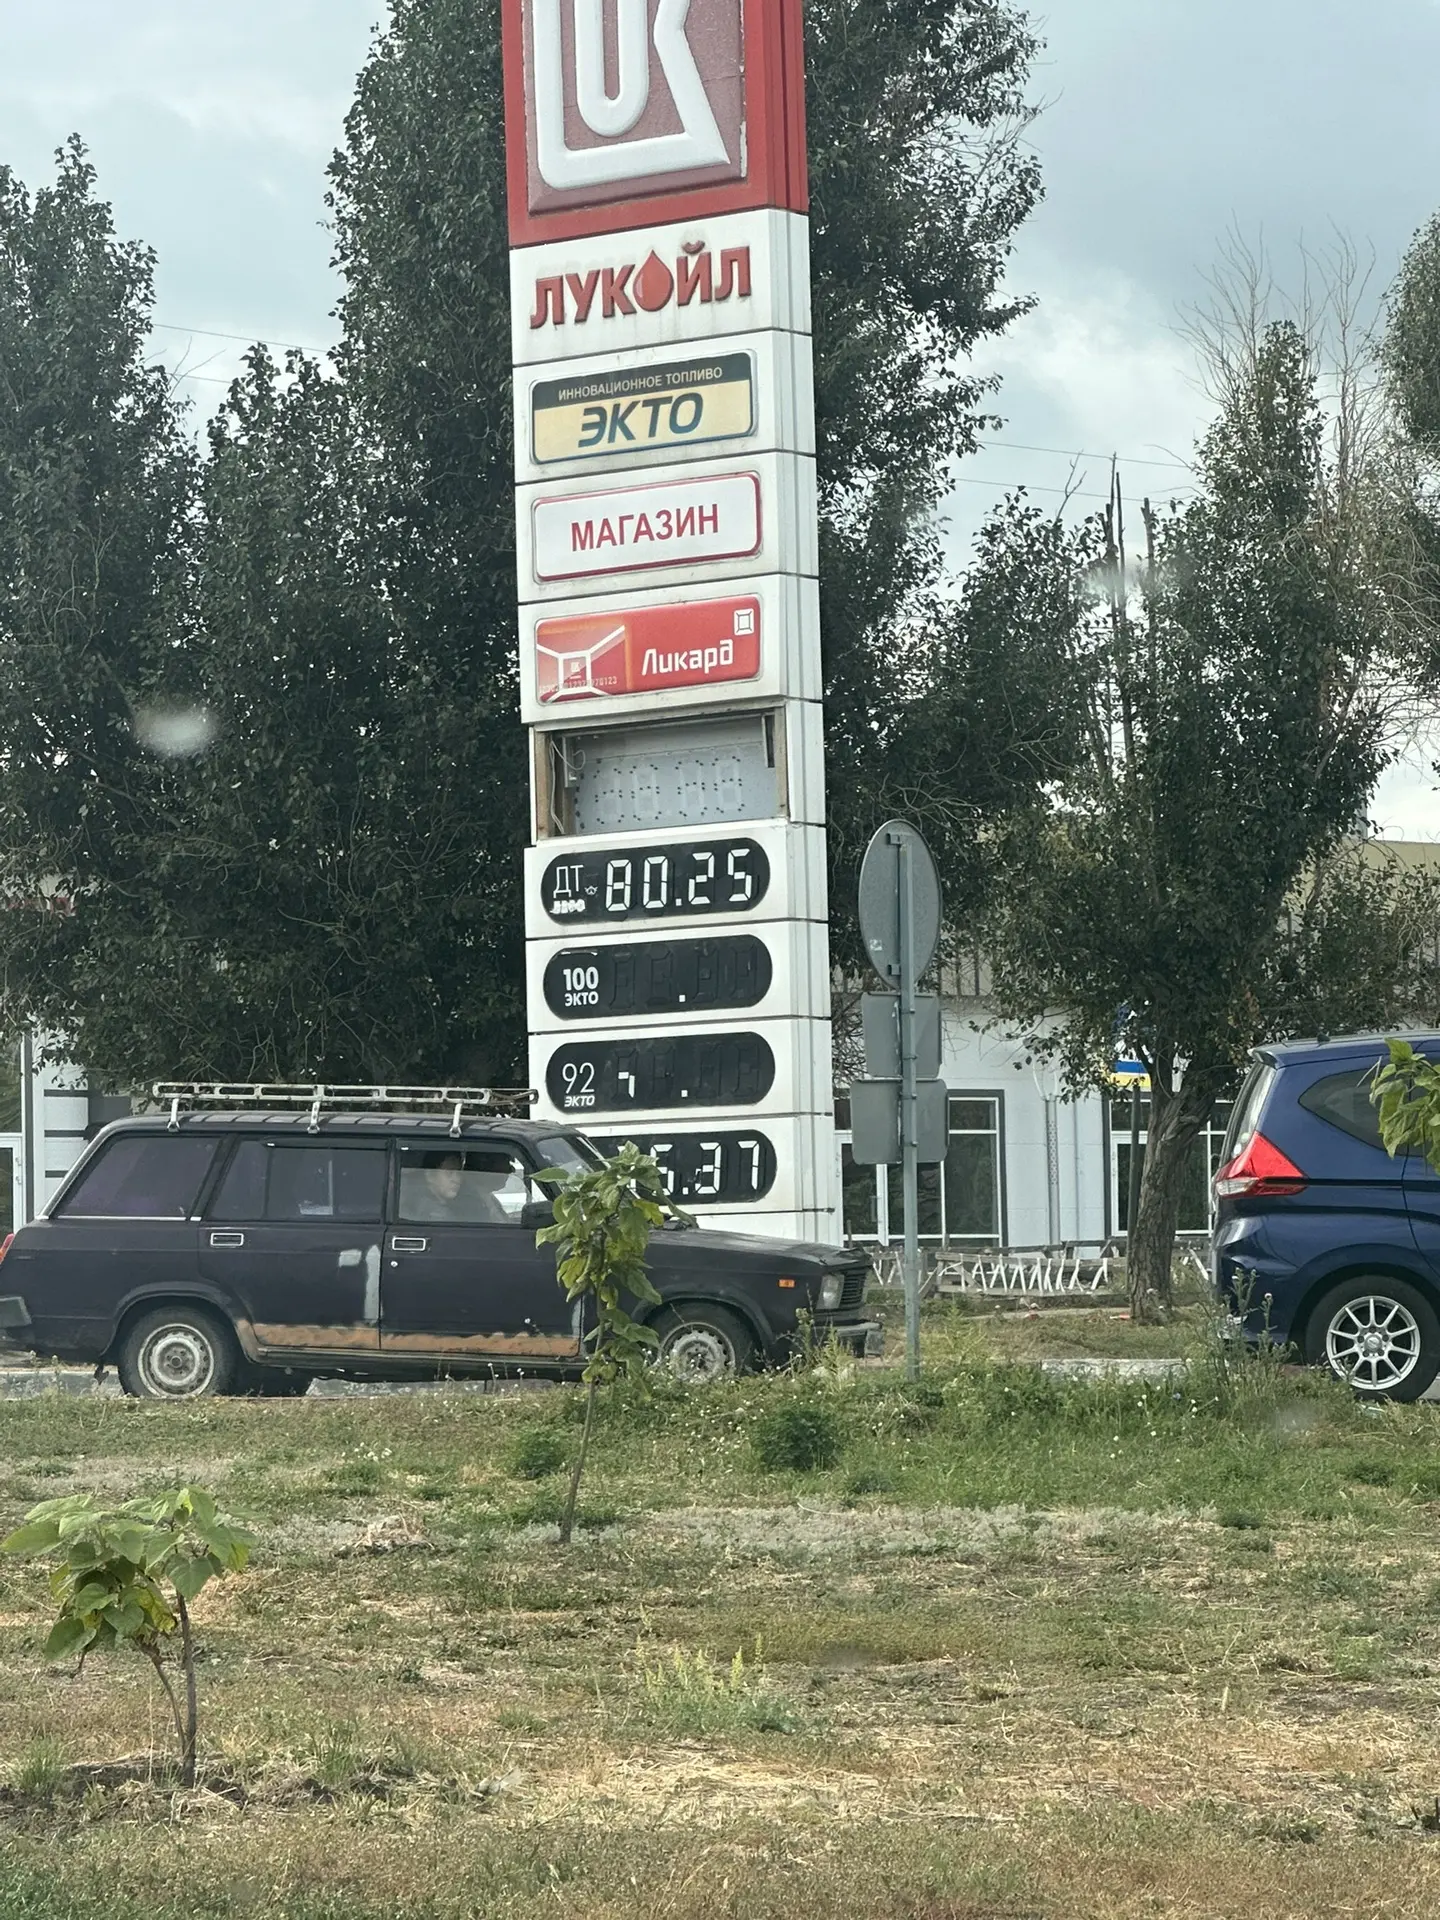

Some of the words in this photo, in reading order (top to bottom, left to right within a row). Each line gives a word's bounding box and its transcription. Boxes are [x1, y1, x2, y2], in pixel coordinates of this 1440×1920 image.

[530, 240, 751, 328] ЛУКОЙЛ
[558, 376, 662, 401] ИННОВАЦИОННОЕ
[666, 367, 723, 386] ТОПЛИВО
[578, 393, 704, 448] ЭКТО
[571, 503, 719, 551] МАГАЗИН
[641, 639, 734, 676] Ликард
[553, 864, 584, 899] ДТ
[606, 849, 752, 911] 80.25
[563, 967, 599, 990] 100
[564, 991, 599, 1007] ЭКТО
[562, 1062, 595, 1094] 92
[563, 1095, 596, 1108] ЭКТО
